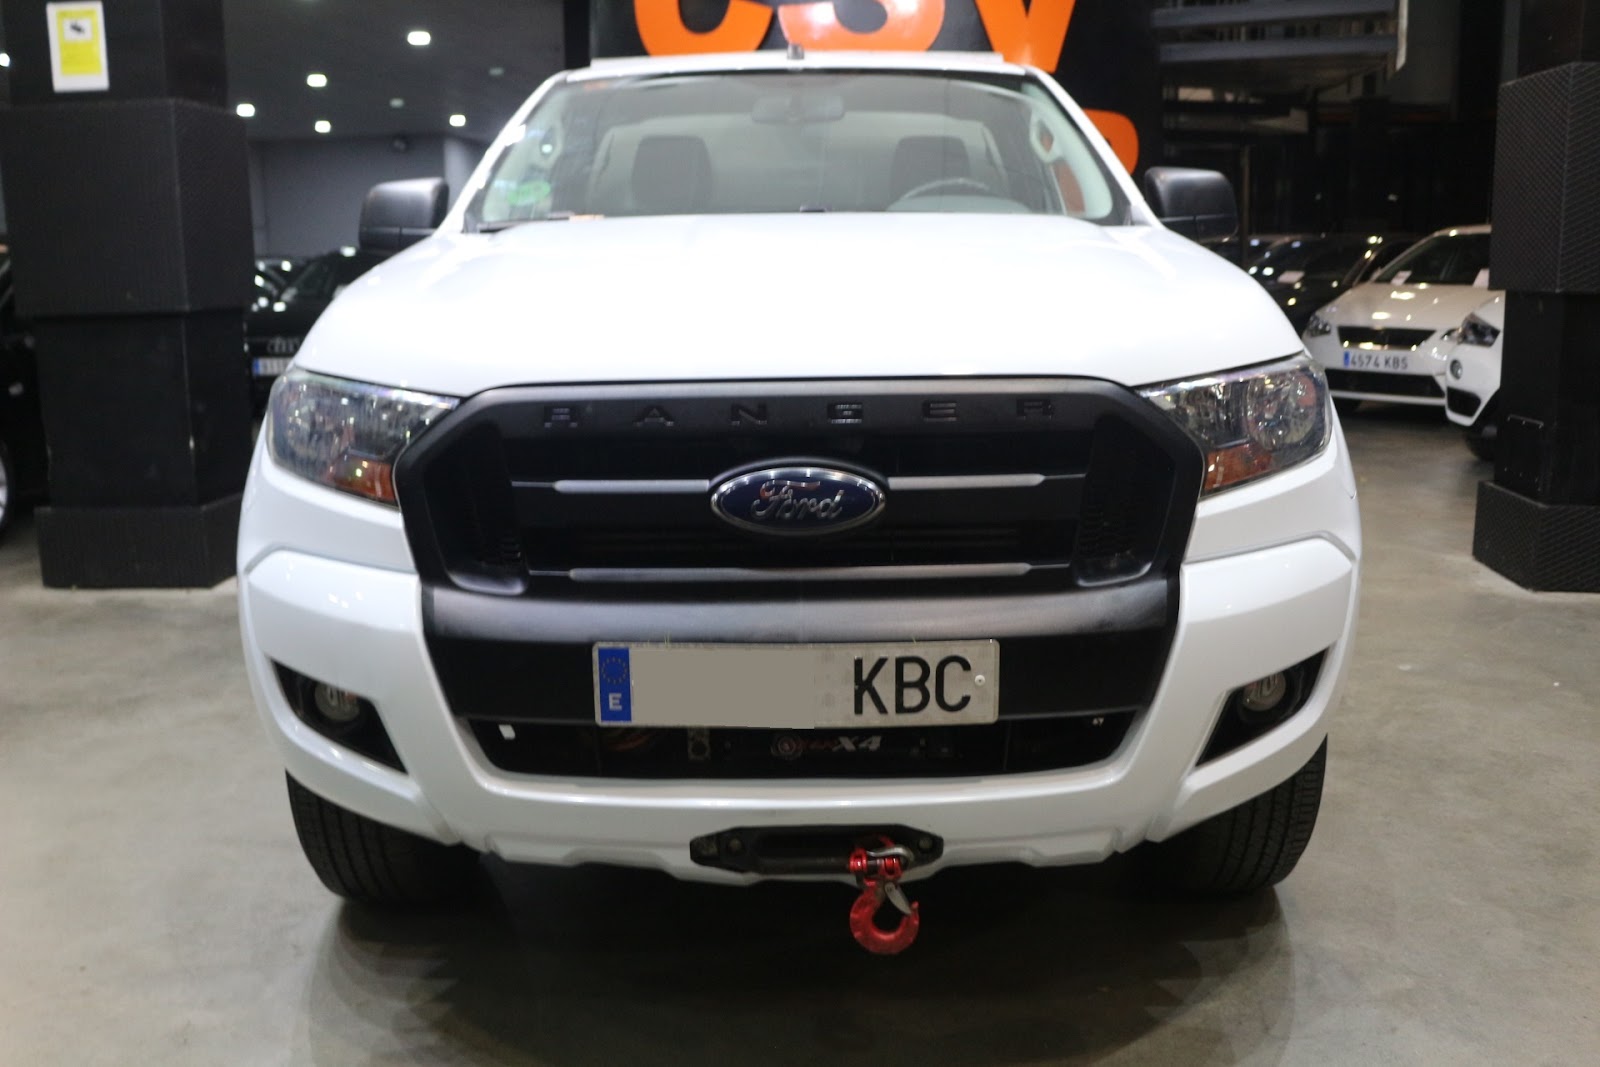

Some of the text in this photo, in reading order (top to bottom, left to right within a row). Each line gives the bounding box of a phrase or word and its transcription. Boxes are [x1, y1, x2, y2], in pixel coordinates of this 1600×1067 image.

[543, 400, 1053, 428] RANGER
[751, 479, 845, 519] Ford
[607, 692, 622, 711] E
[853, 655, 972, 715] KBC
